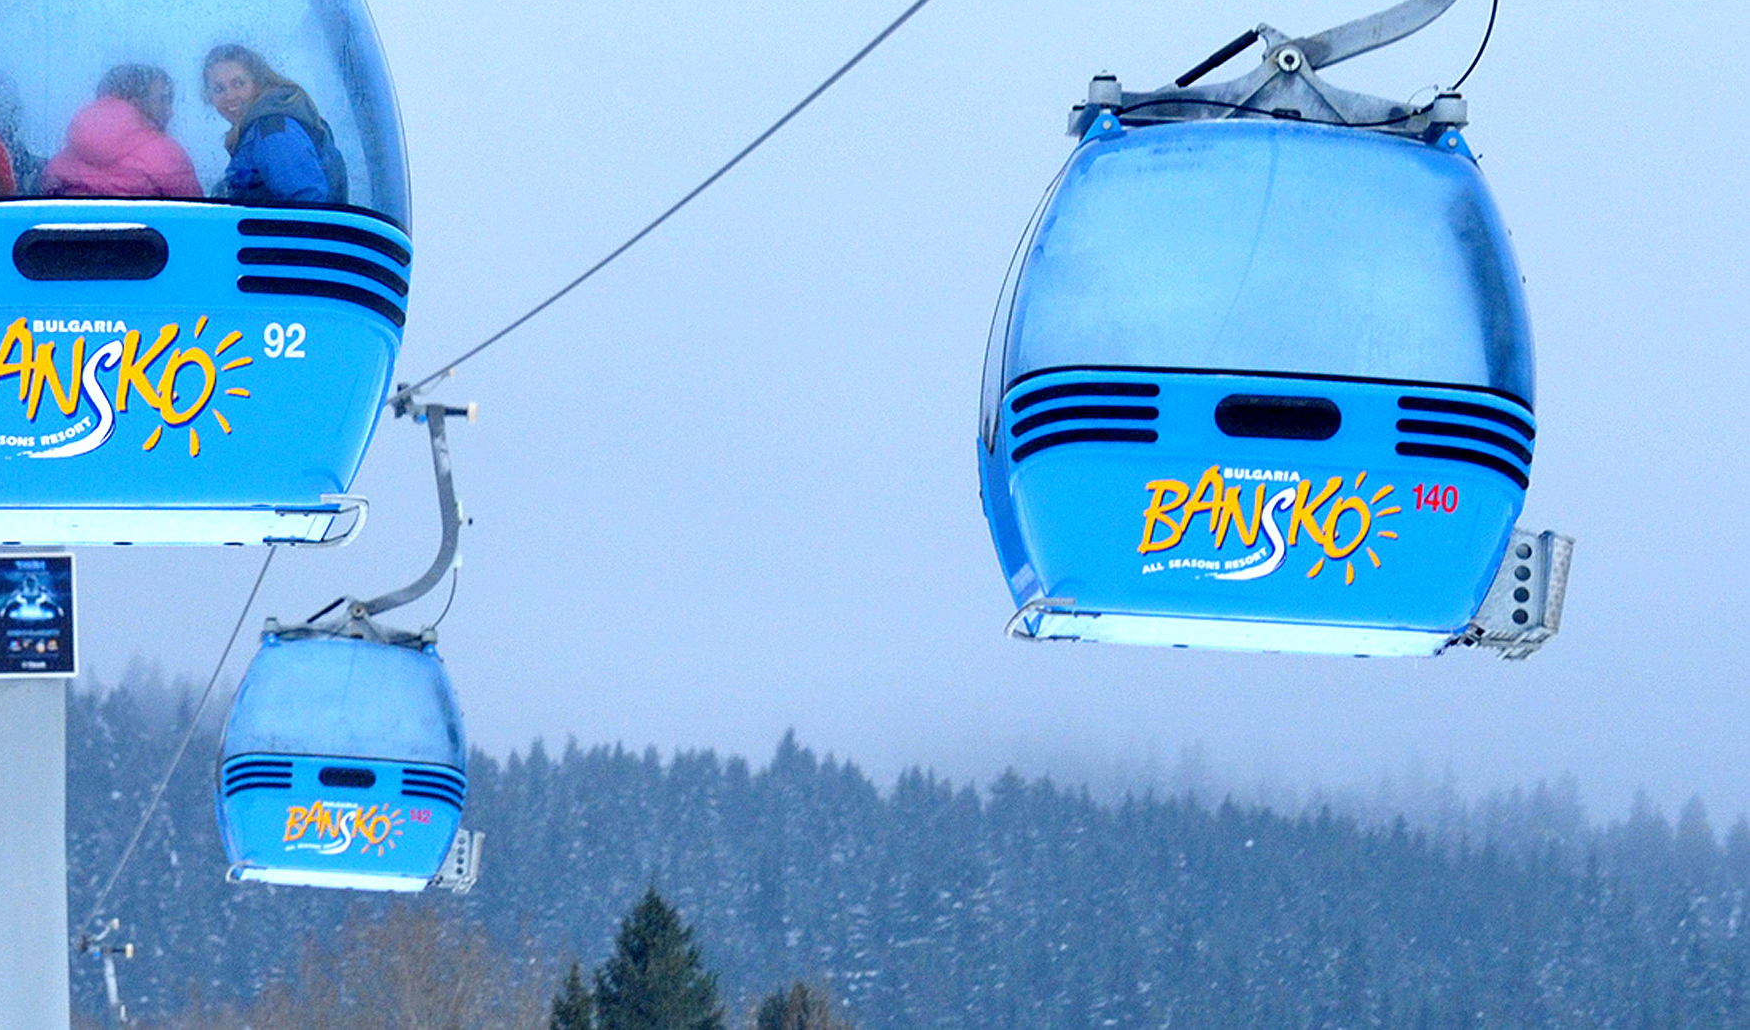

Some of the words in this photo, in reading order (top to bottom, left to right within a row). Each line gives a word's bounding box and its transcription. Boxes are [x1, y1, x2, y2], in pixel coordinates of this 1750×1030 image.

[33, 319, 128, 334] BULGARIA
[263, 322, 307, 359] 92
[40, 416, 92, 447] RESORT
[1223, 467, 1301, 482] BULGARIA
[1412, 482, 1459, 513] 140
[1138, 464, 1372, 580] BANSKO
[1142, 561, 1165, 575] ALL
[1168, 558, 1221, 571] SEASONS
[1224, 546, 1268, 570] RESORT
[283, 799, 392, 855] BANSKO
